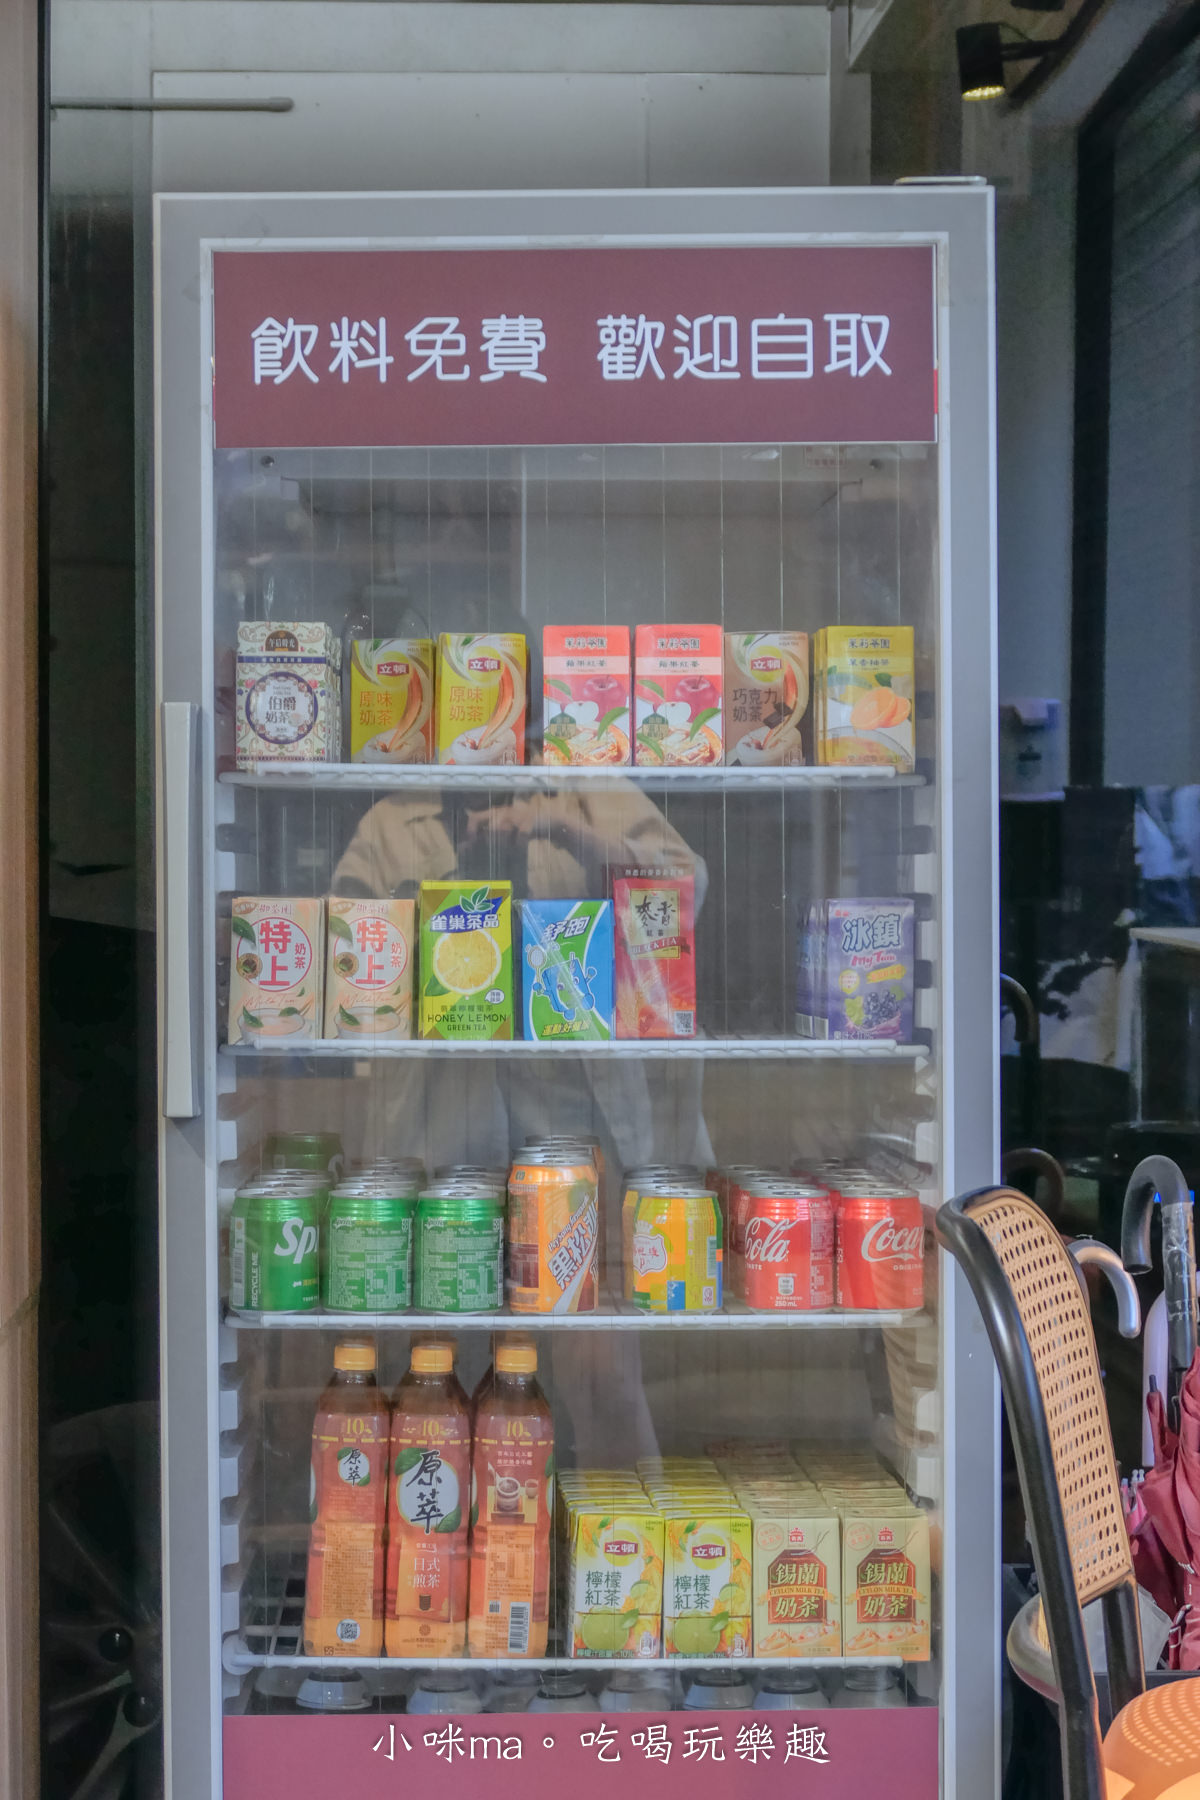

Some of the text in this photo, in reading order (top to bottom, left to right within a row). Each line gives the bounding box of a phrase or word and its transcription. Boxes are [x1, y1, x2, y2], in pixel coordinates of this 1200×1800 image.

[251, 313, 893, 385] 飲料免費 歡迎自取
[379, 664, 407, 674] 立頓
[469, 659, 499, 670] 立頓
[752, 659, 781, 670] 立頓
[269, 696, 297, 711] 伯爵
[360, 690, 393, 707] 原味
[449, 686, 483, 703] 原味
[733, 688, 778, 705] 巧克力
[265, 711, 288, 724] 奶茶
[360, 709, 393, 726] 奶茶
[449, 705, 484, 722] 奶茶
[733, 706, 763, 722] 奶茶
[430, 914, 500, 931] 雀巢茶品
[541, 915, 591, 944] 舒跑
[842, 913, 901, 953] 冰鎮
[259, 920, 292, 987] 特上
[294, 942, 306, 969] 奶茶
[355, 919, 389, 985] 特上
[391, 940, 402, 968] 奶茶
[427, 1012, 507, 1023] HONEY LEMON
[446, 1023, 487, 1031] GREEN TEA
[745, 1216, 799, 1263] Cola
[251, 1251, 259, 1307] RECYCLE ME
[343, 1448, 362, 1487] 原萃
[405, 1449, 445, 1535] 原萃
[606, 1543, 636, 1554] 立頓
[694, 1547, 724, 1558] 立頓
[413, 1556, 441, 1572] 日式
[865, 1562, 909, 1584] 錫蘭
[412, 1573, 440, 1589] 煎茶
[586, 1570, 623, 1589] 檸檬
[776, 1562, 820, 1585] 錫蘭
[674, 1574, 711, 1593] 檸檬
[585, 1589, 622, 1607] 紅茶
[674, 1593, 711, 1611] 紅茶
[863, 1595, 909, 1618] 奶茶
[774, 1596, 820, 1619] 奶茶
